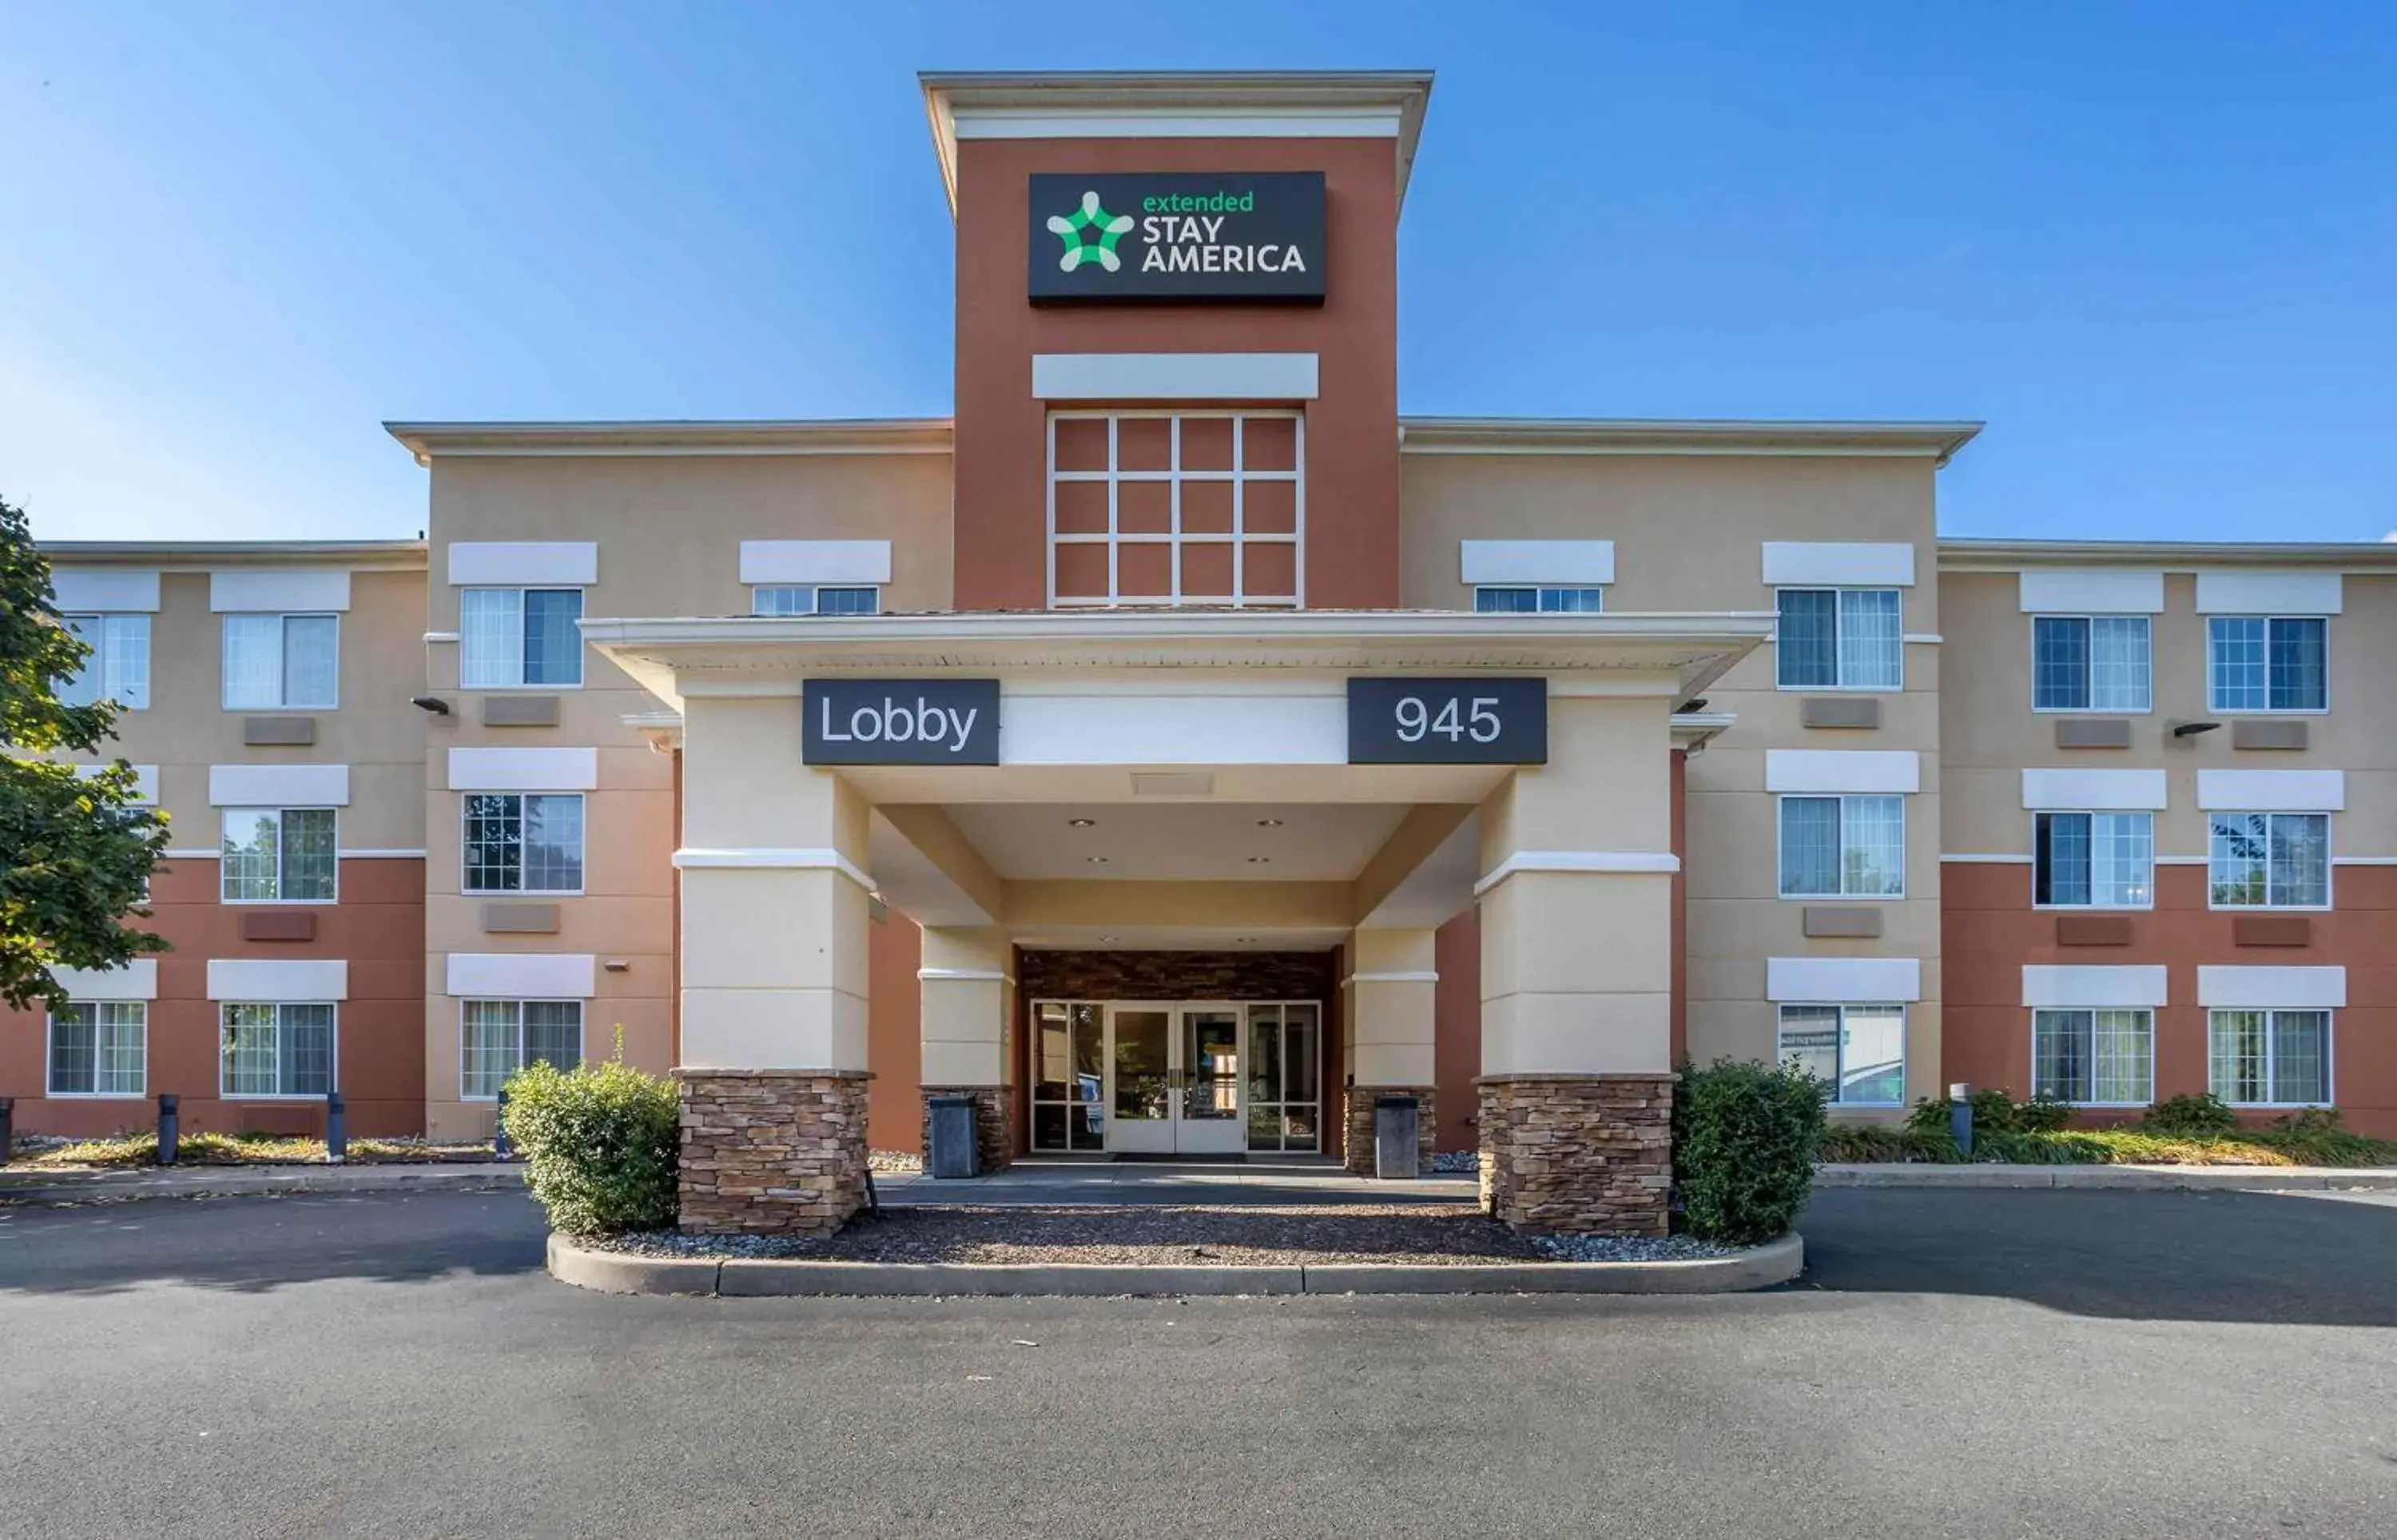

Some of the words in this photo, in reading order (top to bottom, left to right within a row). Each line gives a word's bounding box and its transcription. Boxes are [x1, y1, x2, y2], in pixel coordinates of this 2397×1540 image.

[1143, 191, 1254, 212] extended
[1143, 216, 1225, 243] STAY
[1142, 245, 1306, 272] AMERICA
[822, 697, 977, 752] Lobby
[1395, 697, 1501, 742] 945
